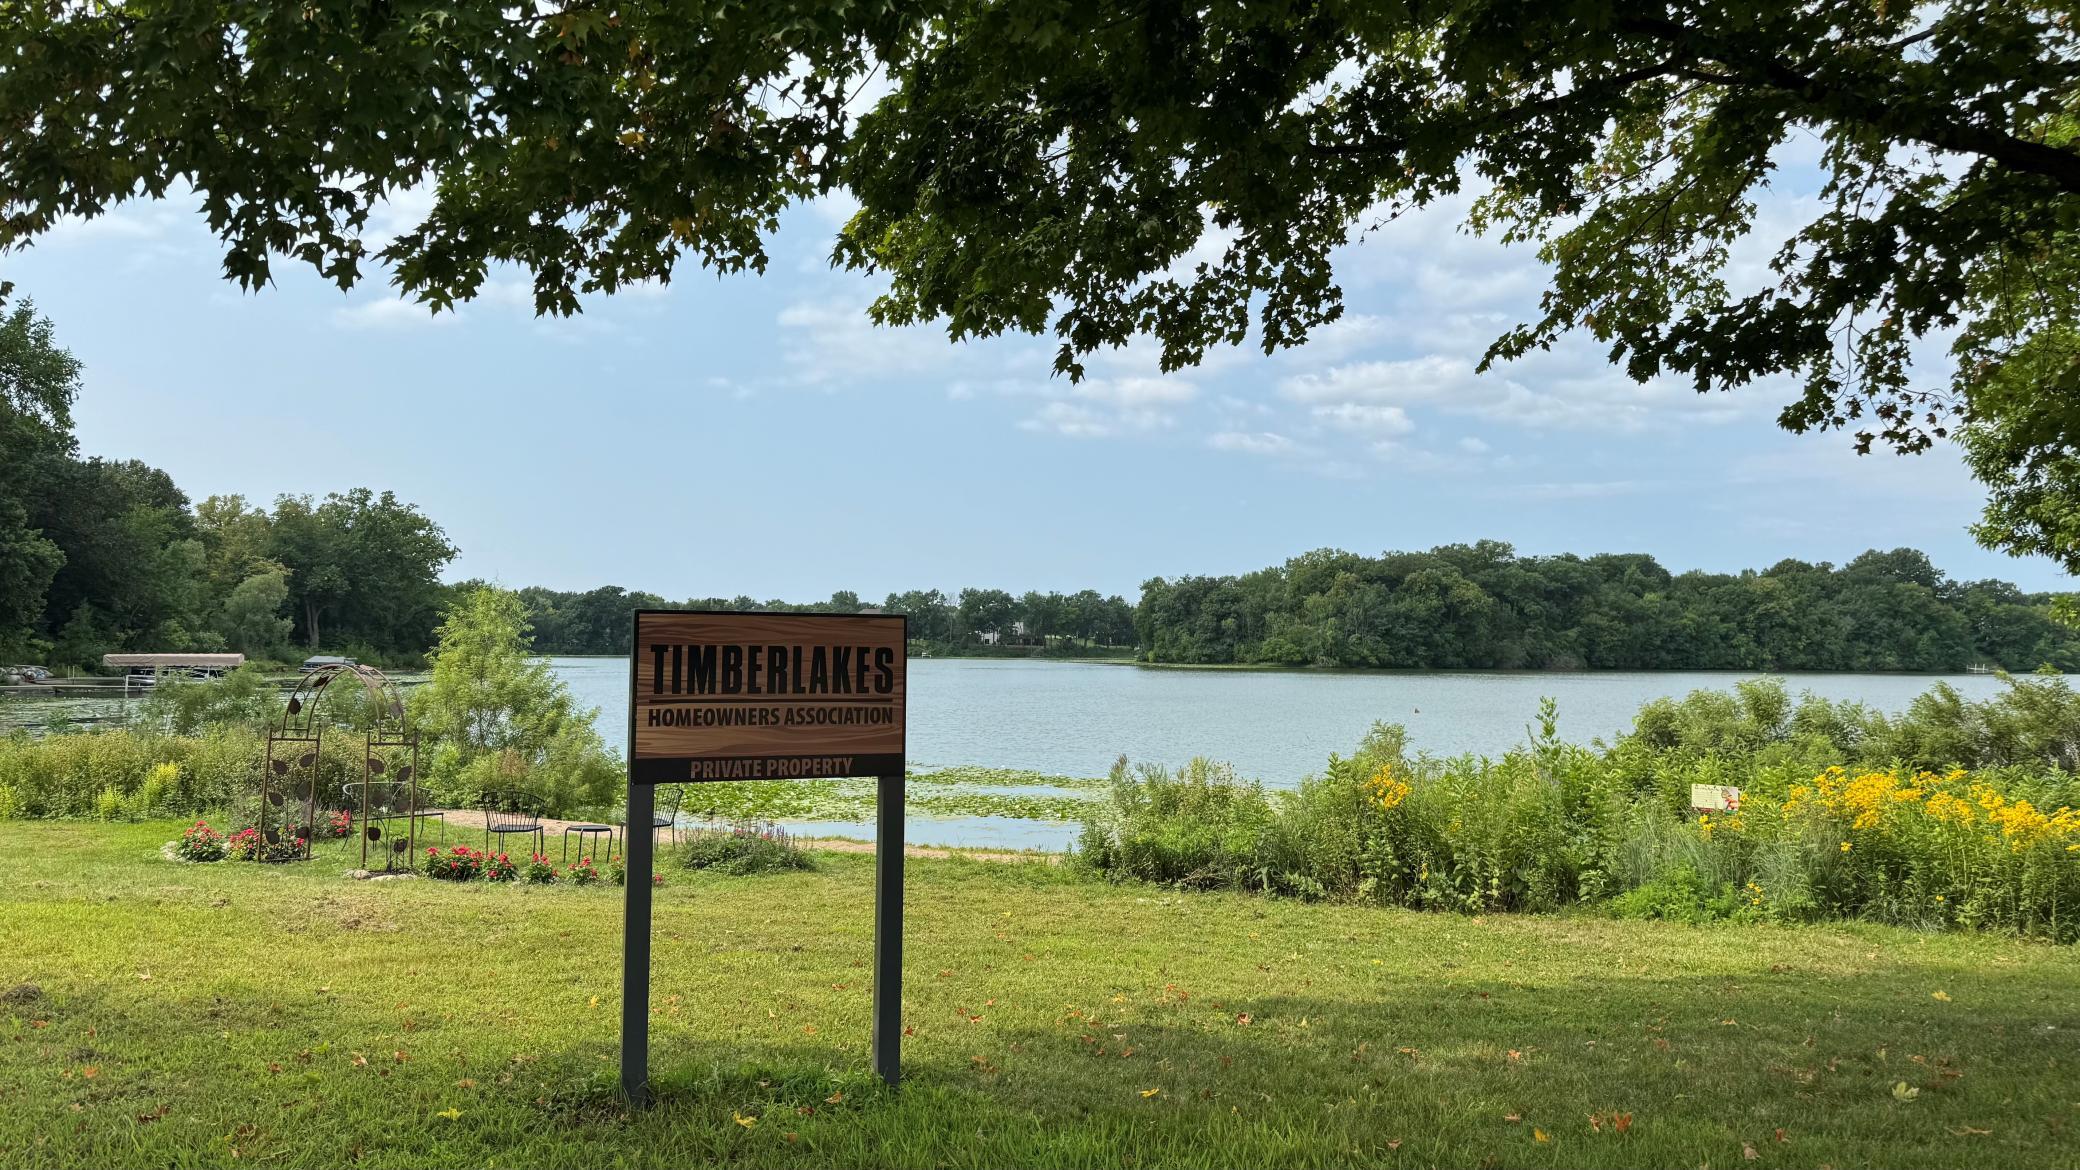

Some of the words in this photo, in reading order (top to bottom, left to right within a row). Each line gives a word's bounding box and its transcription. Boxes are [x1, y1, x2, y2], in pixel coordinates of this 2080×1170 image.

[651, 644, 894, 695] TIMBERLAKES
[648, 707, 780, 727] HOMEOWNERS
[784, 706, 893, 725] ASSOCIATION
[690, 759, 762, 778] PRIVATE
[766, 757, 853, 777] PROPERTY
